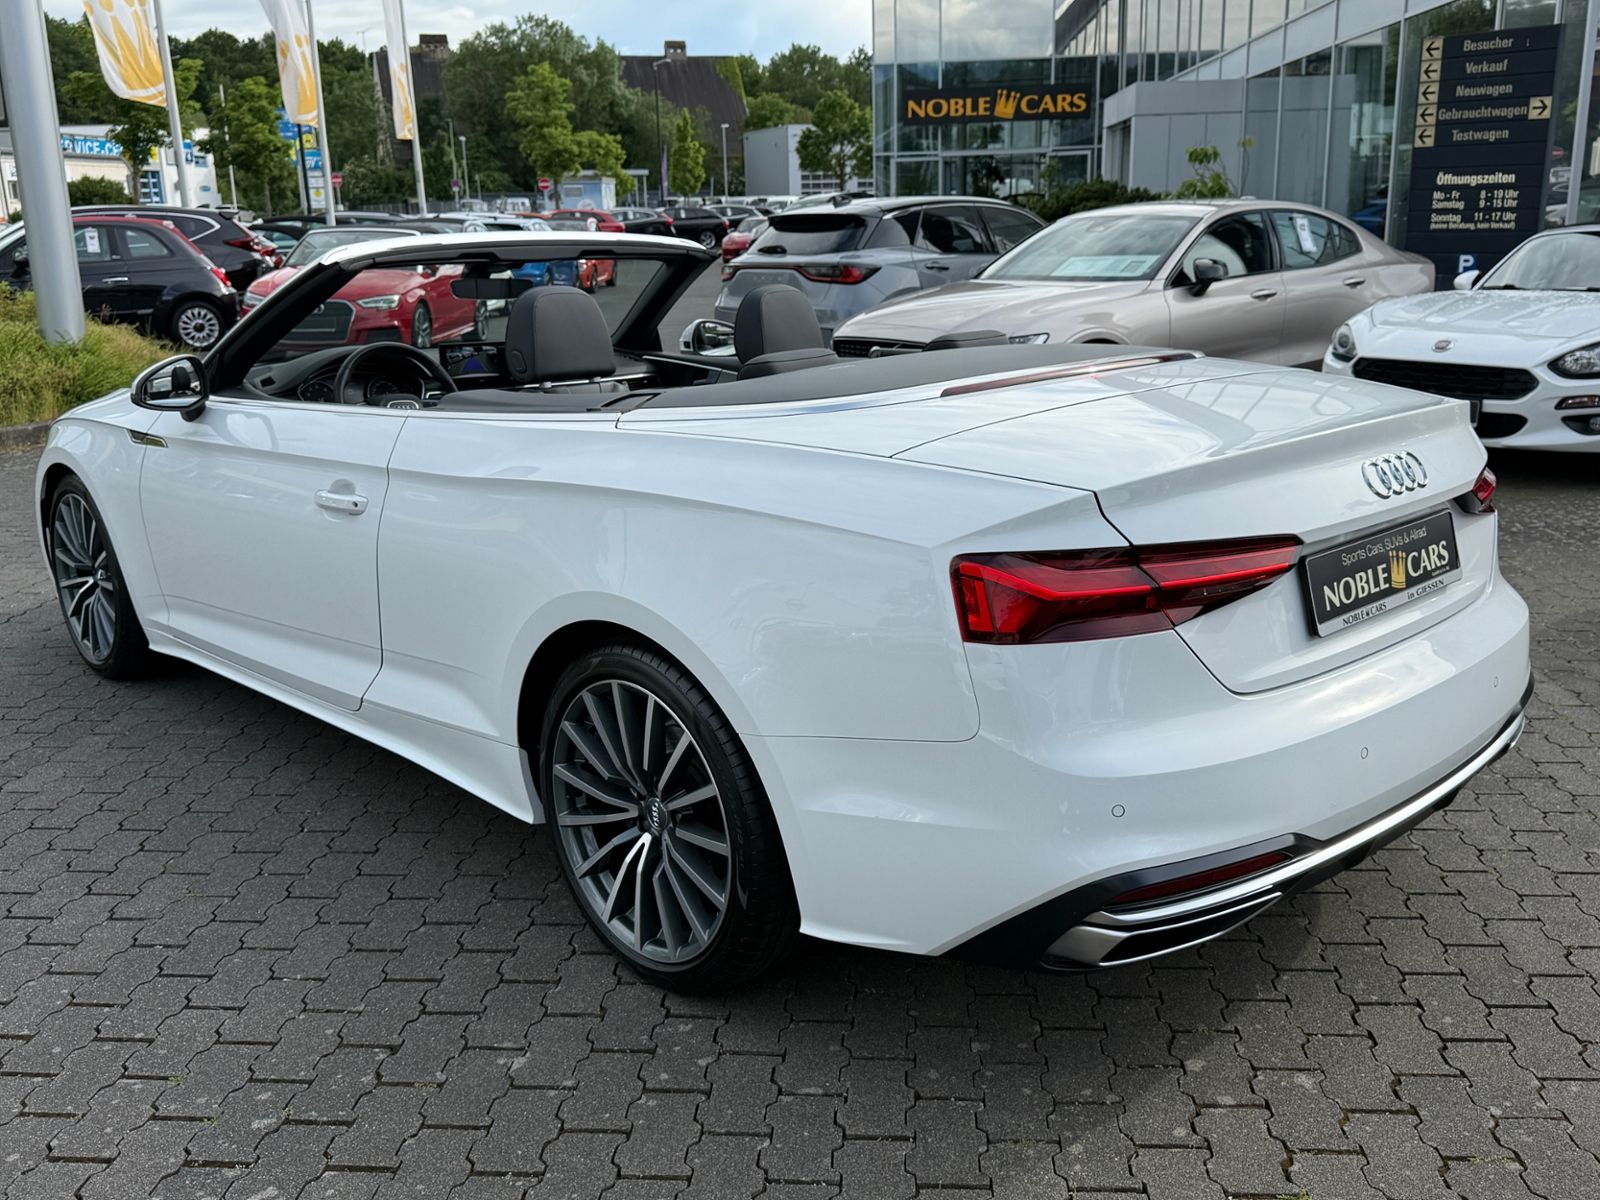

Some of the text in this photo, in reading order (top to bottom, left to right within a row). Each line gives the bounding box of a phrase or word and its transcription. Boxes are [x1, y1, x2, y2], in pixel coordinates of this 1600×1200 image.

[1463, 36, 1514, 52] Besucher
[1465, 58, 1508, 74] Verkauf
[1455, 83, 1513, 97] Neuwagen
[907, 92, 1087, 119] NOBLE CARS
[1437, 104, 1528, 121] Gebrauchtwagen
[1451, 129, 1510, 142] Testwagen
[1436, 171, 1516, 187] Öffnungszeiten
[1432, 190, 1446, 200] Mo
[1451, 190, 1461, 200] Fr
[1480, 189, 1487, 199] 8
[1493, 189, 1504, 199] 19
[1504, 188, 1520, 198] Uhr
[1431, 199, 1465, 210] Samstag
[1479, 199, 1486, 208] 9
[1492, 198, 1503, 208] 15
[1503, 198, 1519, 208] Uhr
[1430, 212, 1462, 223] Sonntag
[1474, 211, 1484, 221] 11
[1491, 211, 1502, 221] 17
[1502, 211, 1517, 221] Uhr
[1458, 254, 1475, 273] P
[1341, 549, 1367, 567] Sports
[1403, 532, 1410, 544] &
[1323, 540, 1449, 611] NOBLE CARS
[1407, 578, 1445, 600] in GIESSEN
[1342, 601, 1387, 626] NOBLE CARS
